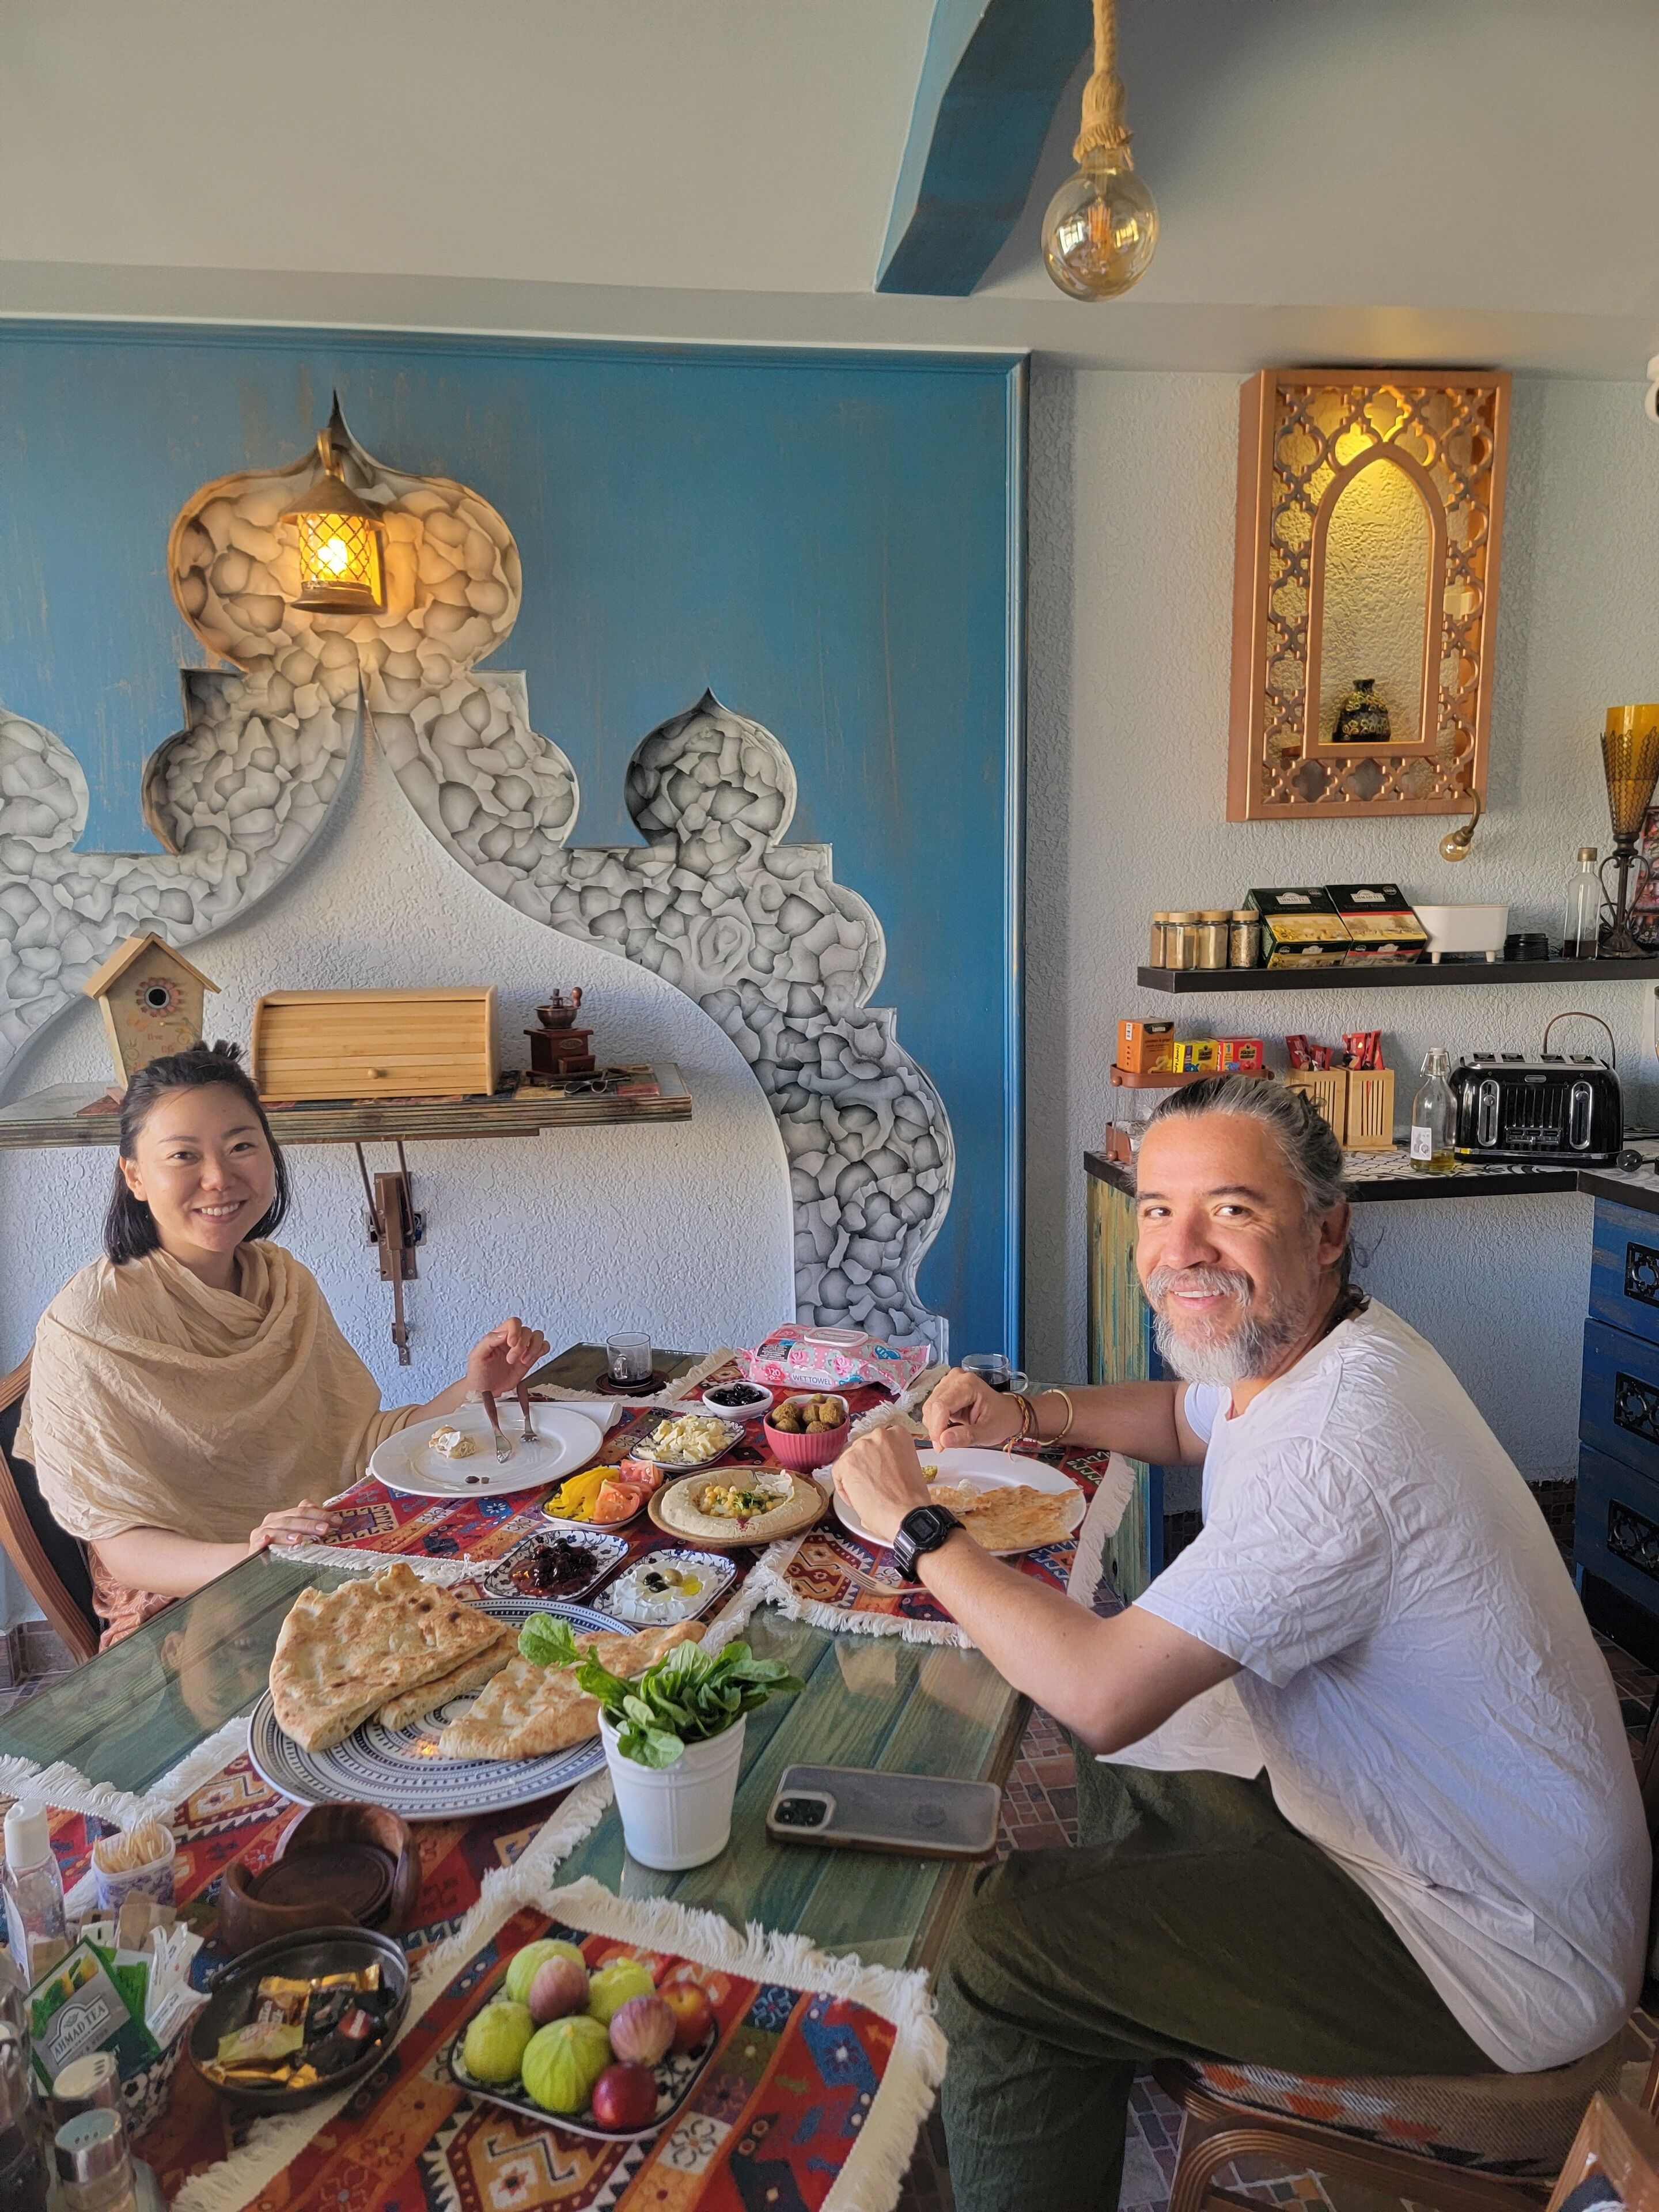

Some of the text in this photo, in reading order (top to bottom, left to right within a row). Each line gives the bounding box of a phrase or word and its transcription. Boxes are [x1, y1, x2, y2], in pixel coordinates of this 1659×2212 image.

[768, 1368, 781, 1376] 120
[793, 1374, 809, 1382] WET
[809, 1376, 831, 1385] TOWEL
[54, 2021, 85, 2057] AHMAD
[86, 2004, 106, 2024] TEA
